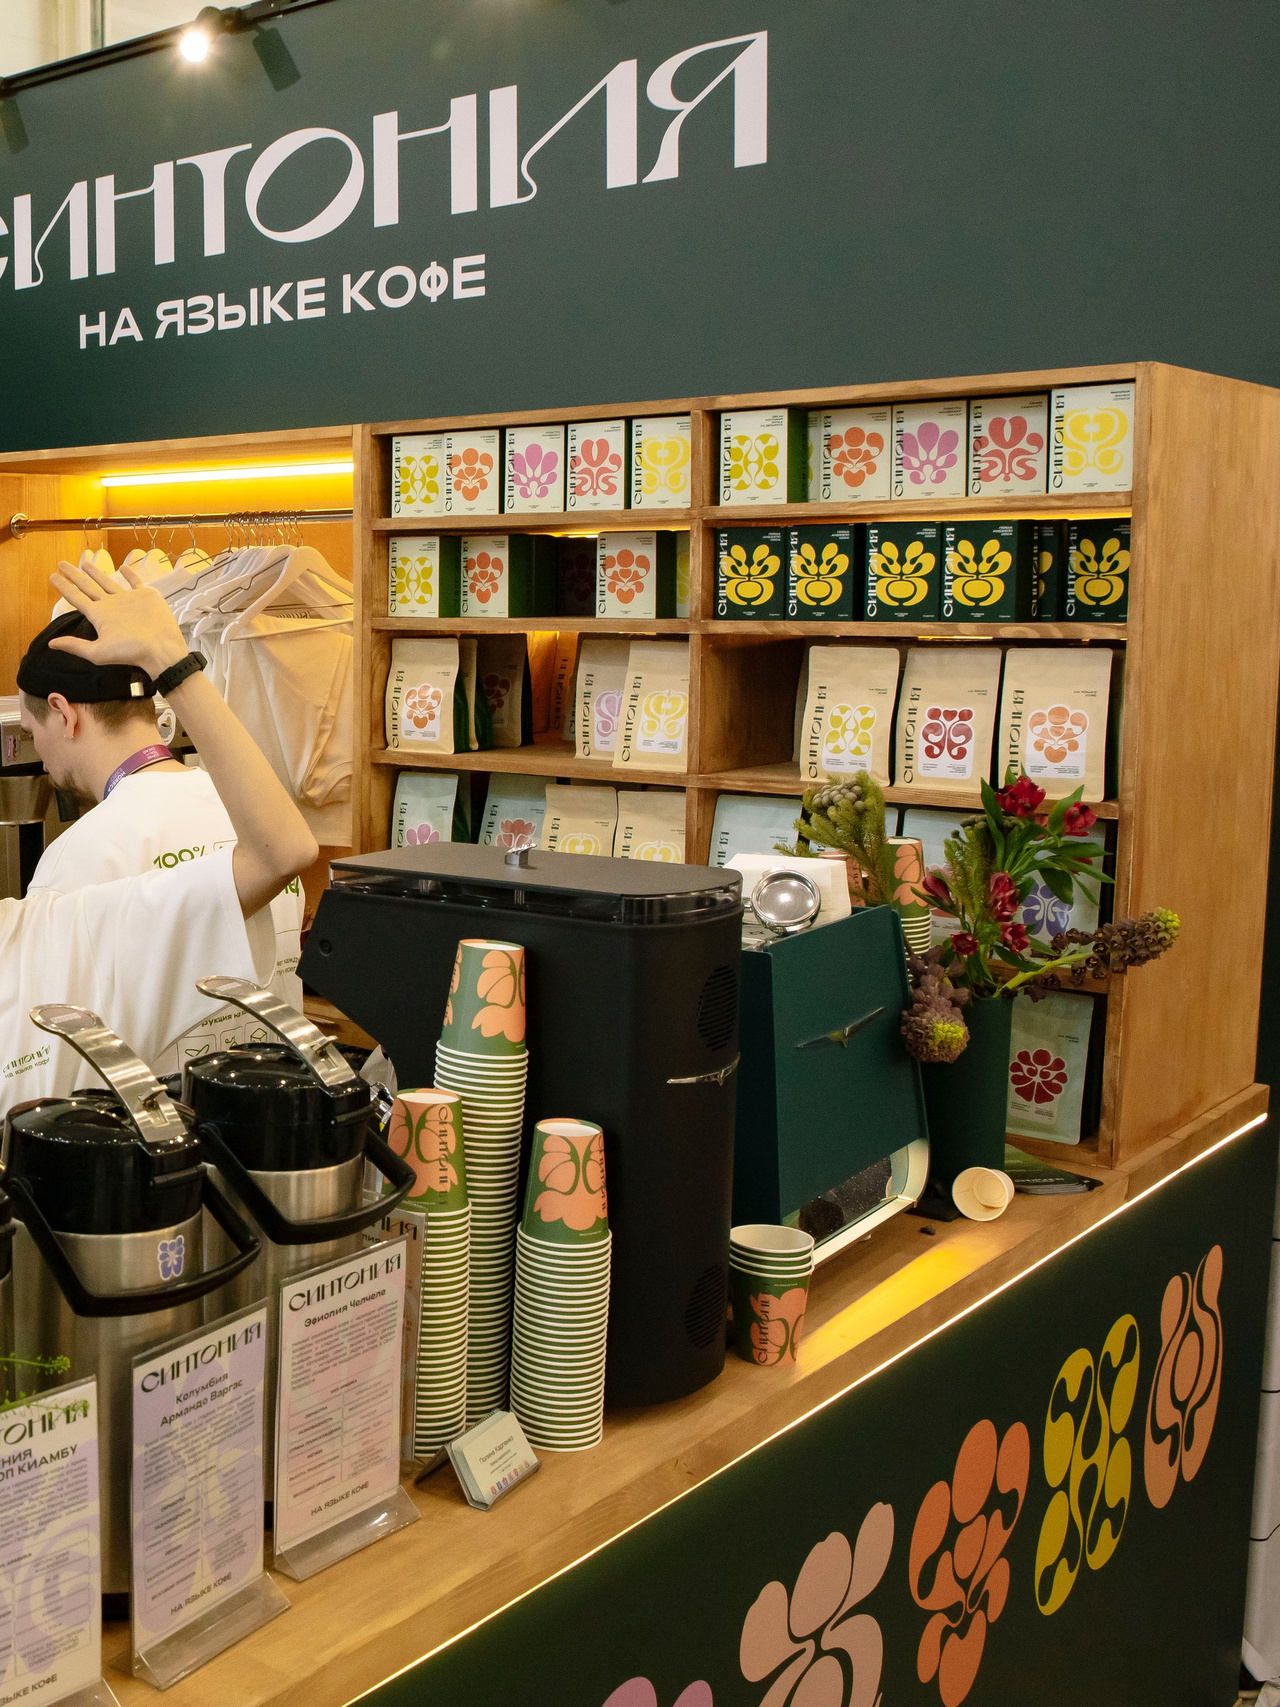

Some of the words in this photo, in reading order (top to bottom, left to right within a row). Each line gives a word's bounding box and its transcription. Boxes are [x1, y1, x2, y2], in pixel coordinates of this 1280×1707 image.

[79, 307, 143, 350] НА
[155, 278, 326, 339] ЯЗЫКЕ
[342, 254, 486, 314] КОФЕ
[809, 686, 827, 778] СИНТОНИЯ
[904, 687, 921, 783] СИНТОНИЯ
[1009, 690, 1024, 776] ИНТОНИЯ
[289, 1254, 400, 1312] СИНТОНИЯ
[304, 1305, 348, 1328] Эфиопия
[350, 1289, 386, 1308] Челчеле
[141, 1321, 260, 1393] СИНТОНИЯ
[161, 1397, 208, 1427] Армандо
[210, 1380, 243, 1402] Варгас
[176, 1373, 228, 1404] Колумбия
[18, 1444, 78, 1474] КИАМБУ
[32, 1674, 57, 1692] КОФЕ
